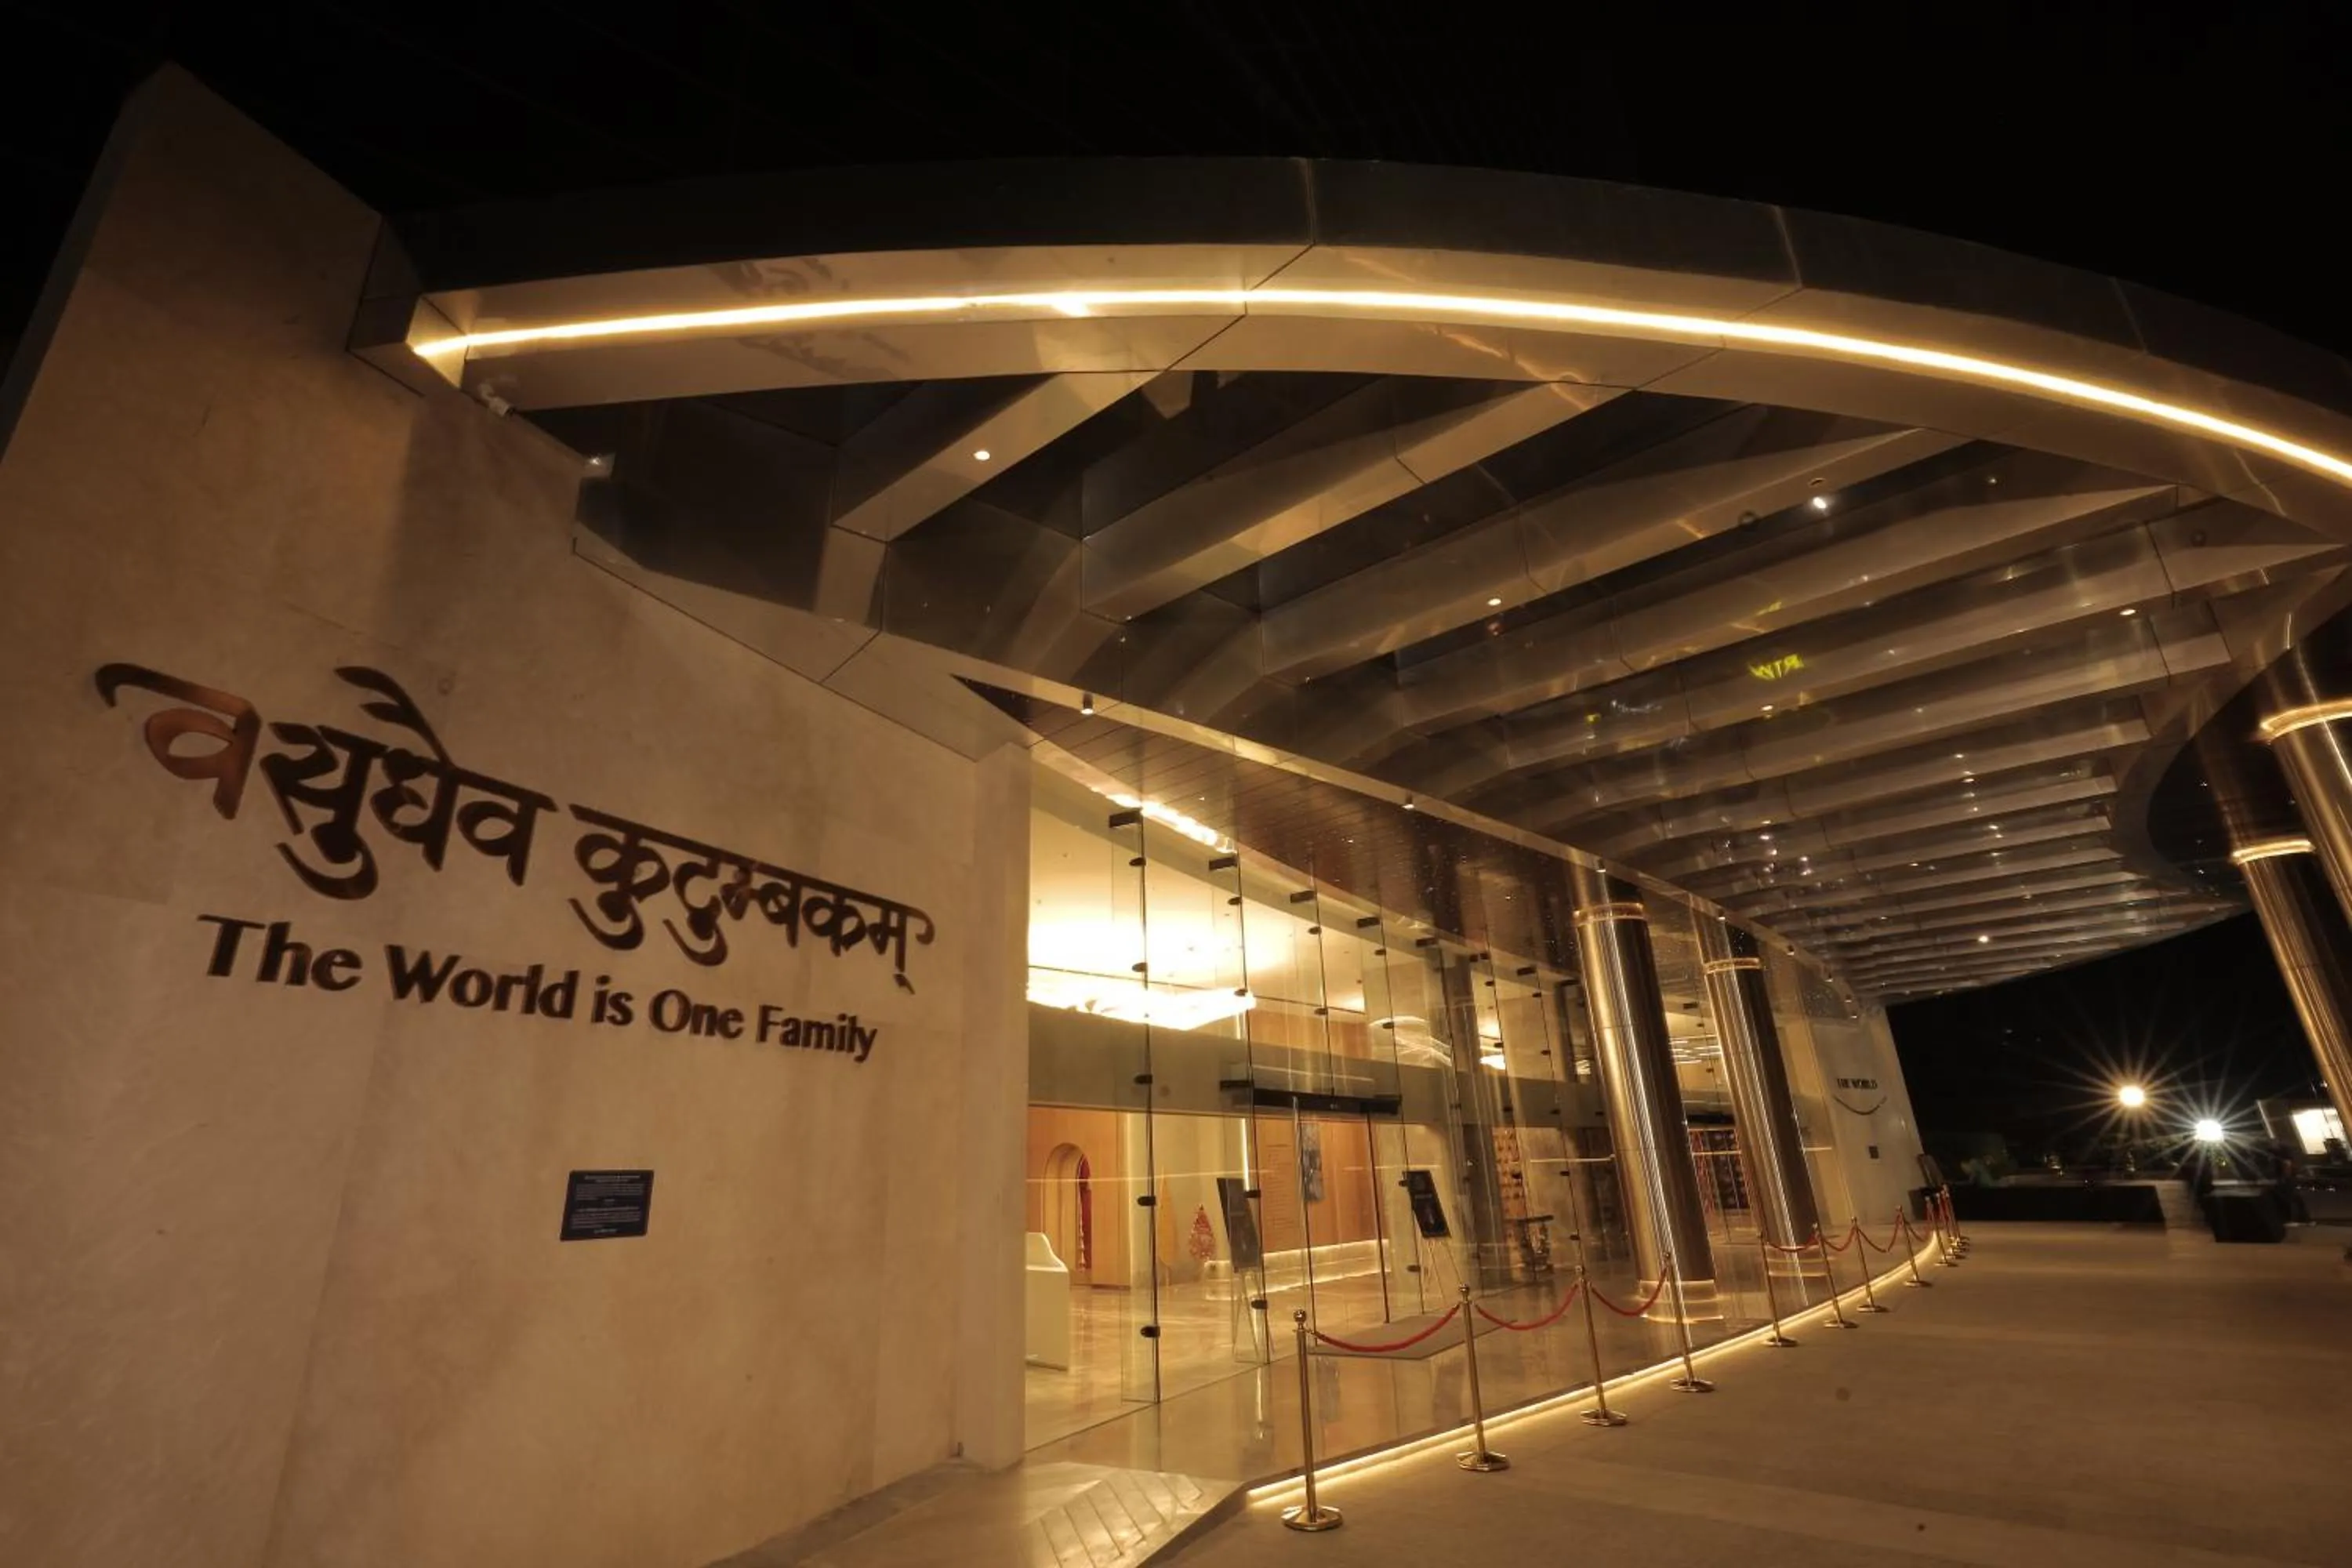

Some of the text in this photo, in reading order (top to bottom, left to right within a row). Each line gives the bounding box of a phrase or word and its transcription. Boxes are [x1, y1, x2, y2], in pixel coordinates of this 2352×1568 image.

[94, 662, 935, 994] वसुधैव कुटुम्बकम्
[197, 913, 877, 1062] The World is One Family
